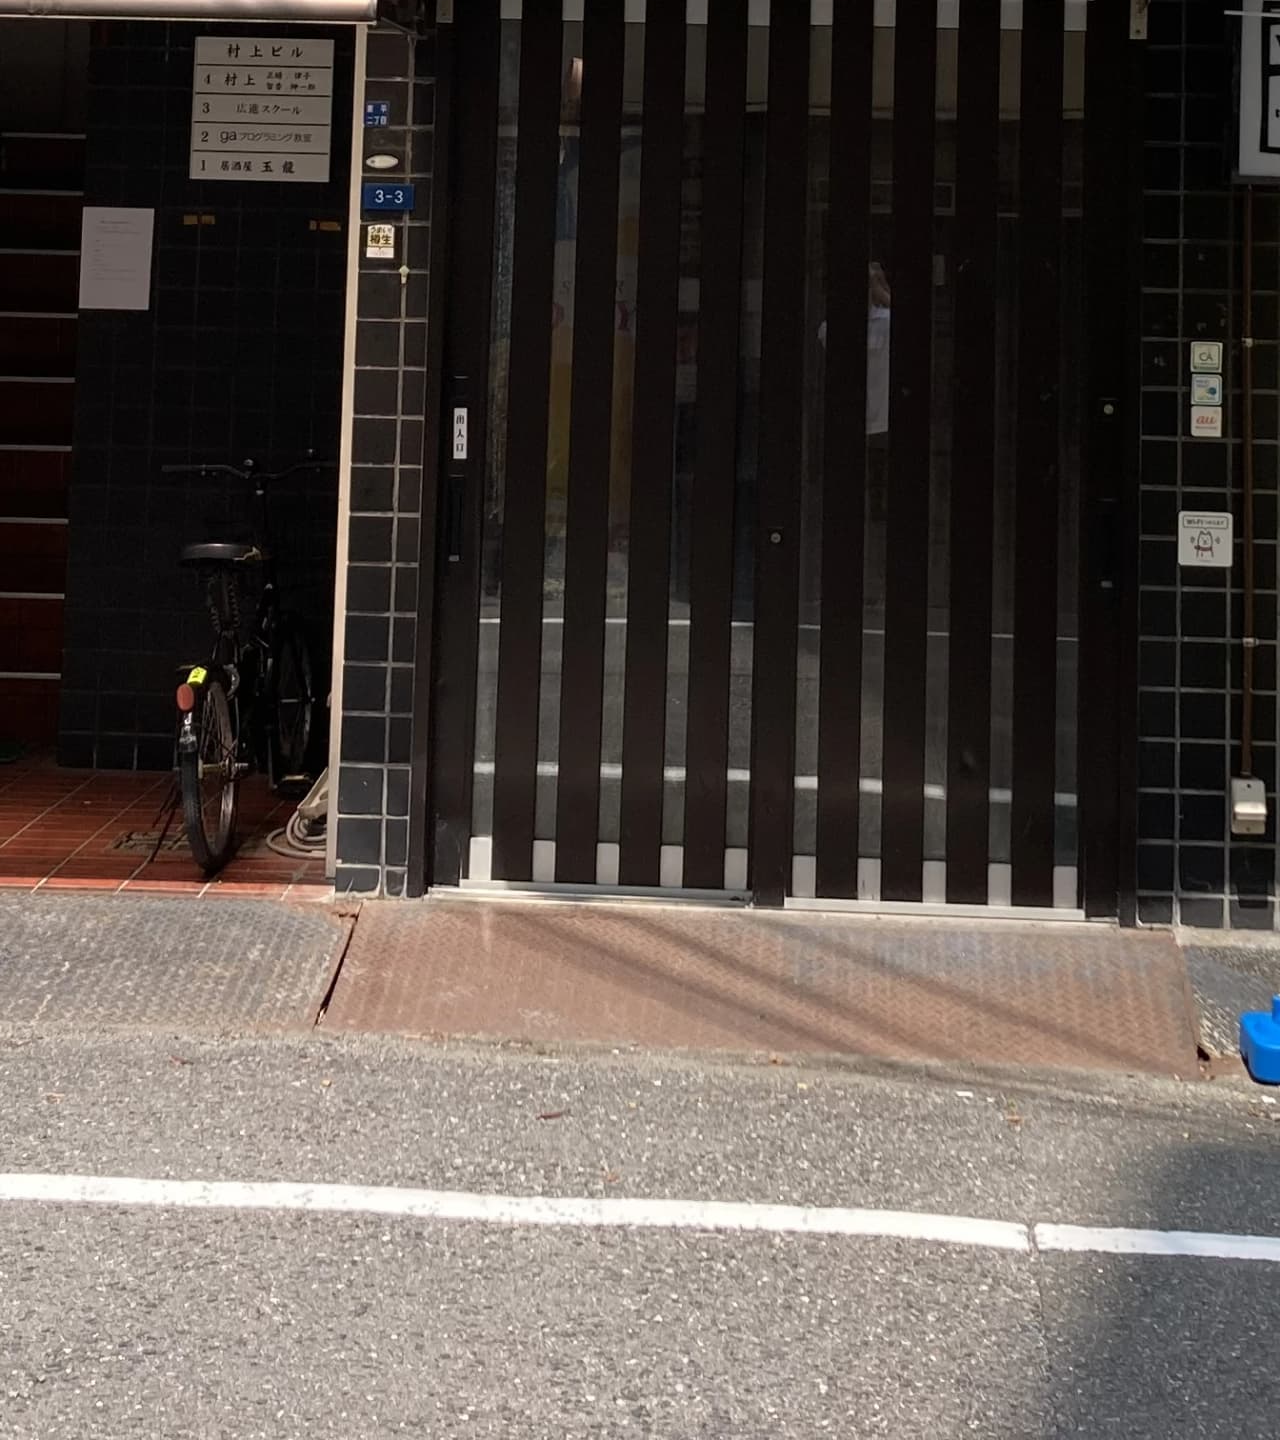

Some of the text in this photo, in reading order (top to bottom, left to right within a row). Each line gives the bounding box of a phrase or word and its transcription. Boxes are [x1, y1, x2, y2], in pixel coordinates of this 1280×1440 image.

[227, 43, 303, 58] 村上ビル
[225, 73, 256, 86] 村上
[202, 102, 210, 114] 3
[201, 131, 209, 142] 2
[375, 190, 404, 203] 3-3
[1196, 415, 1217, 425] au
